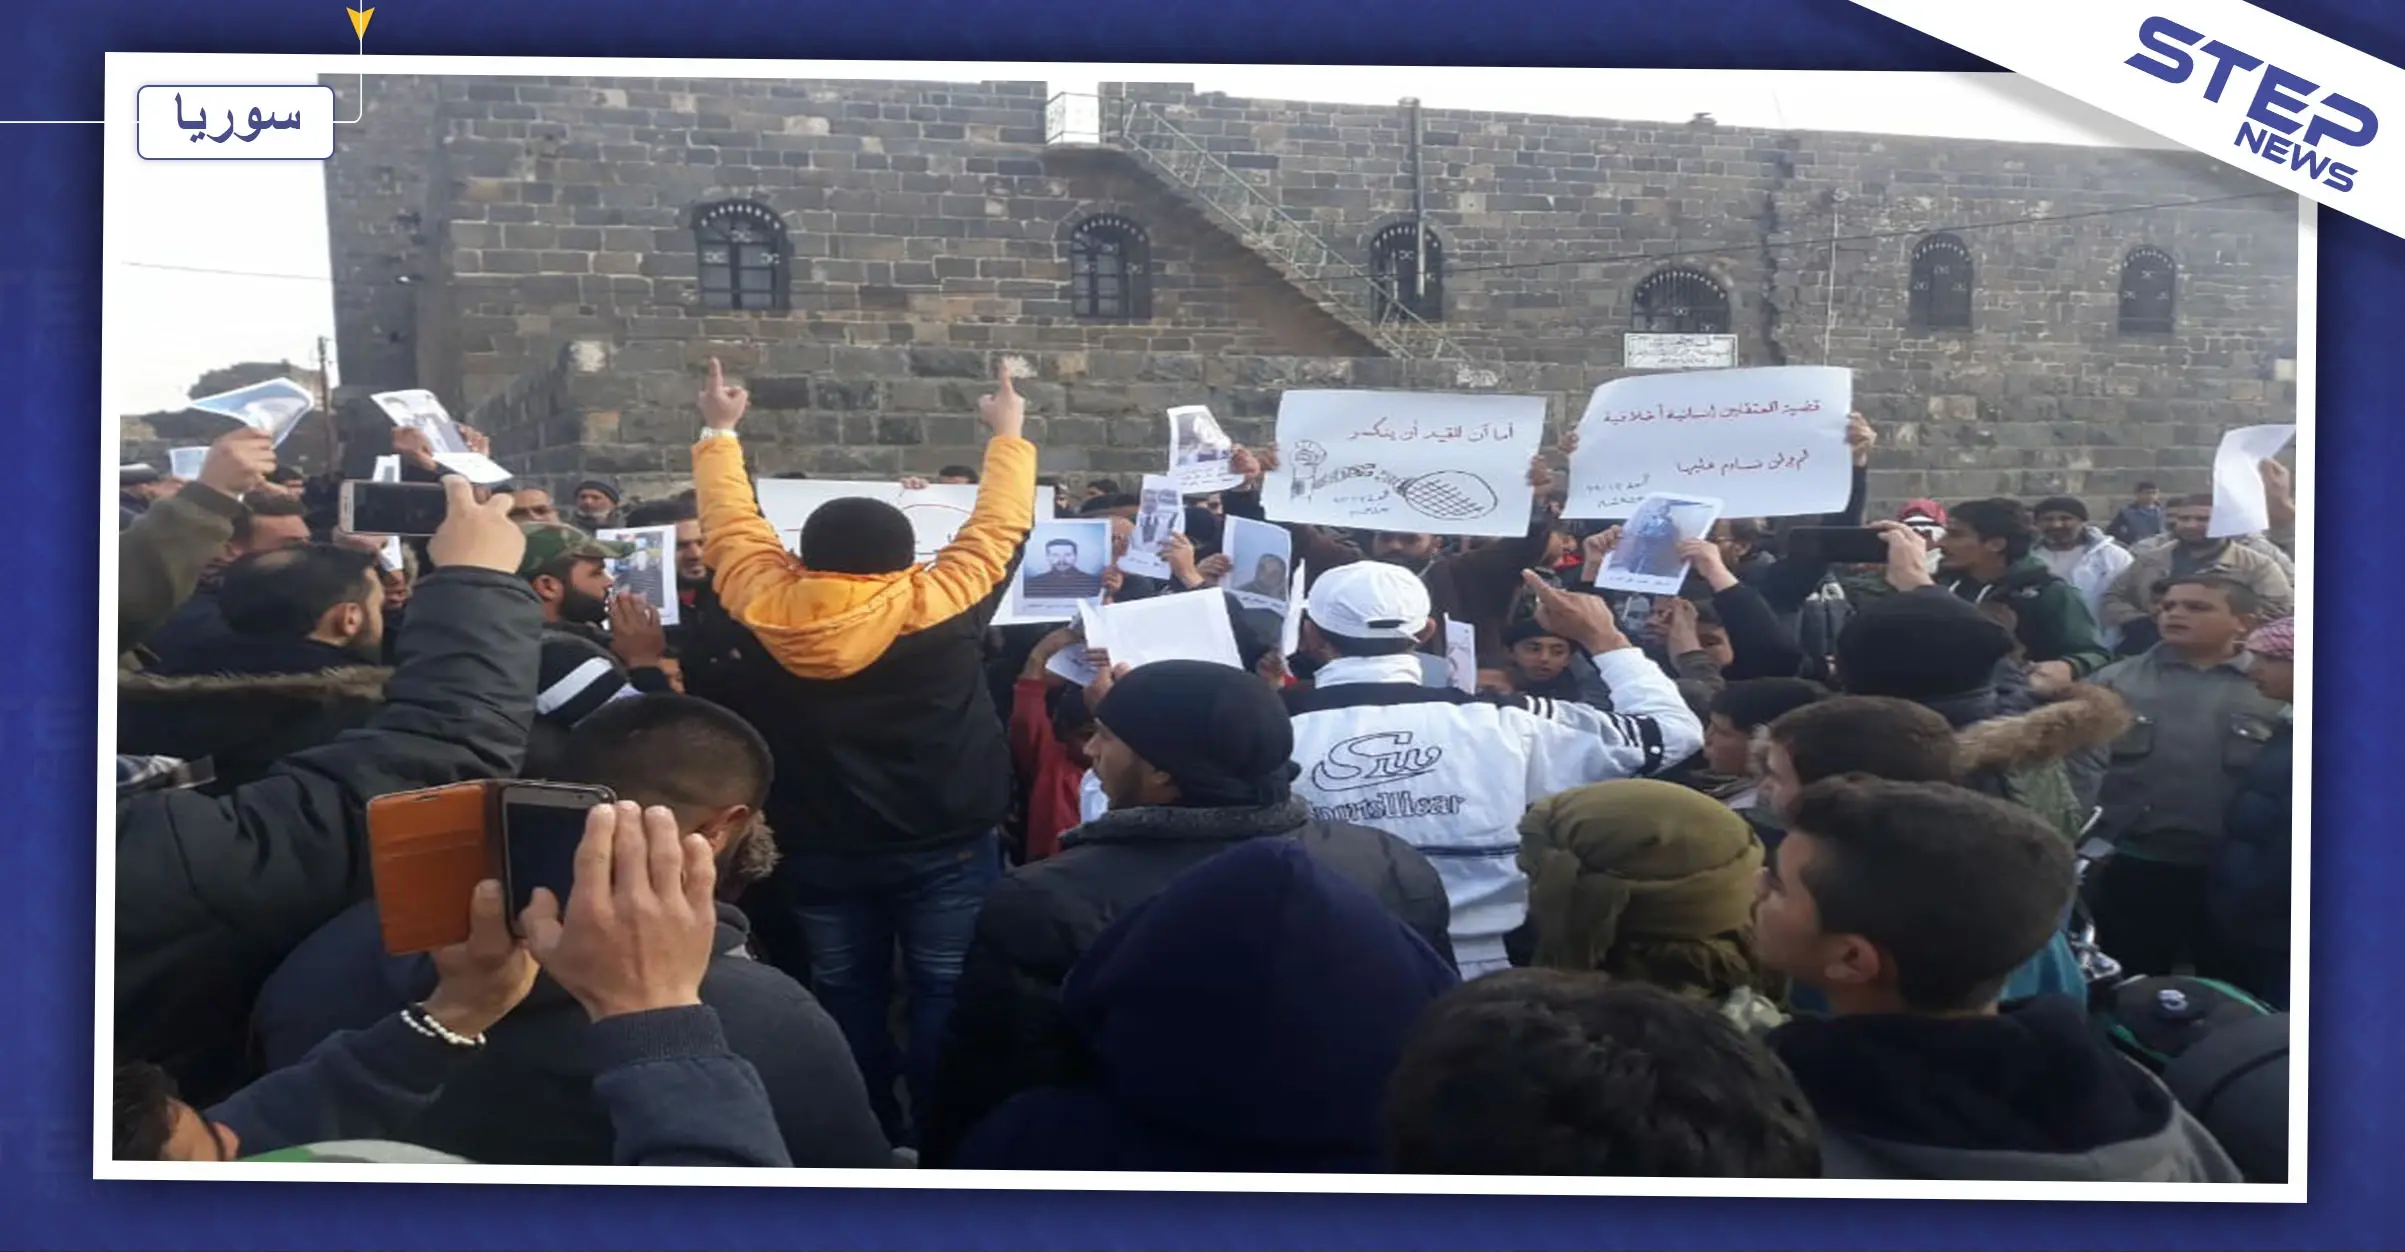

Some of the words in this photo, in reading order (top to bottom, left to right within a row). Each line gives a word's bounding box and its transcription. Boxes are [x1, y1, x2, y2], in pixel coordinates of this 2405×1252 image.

[1347, 416, 1397, 442] ينكسر
[1400, 419, 1419, 441] أن
[1423, 425, 1463, 443] للقيد
[1493, 422, 1514, 441] أما
